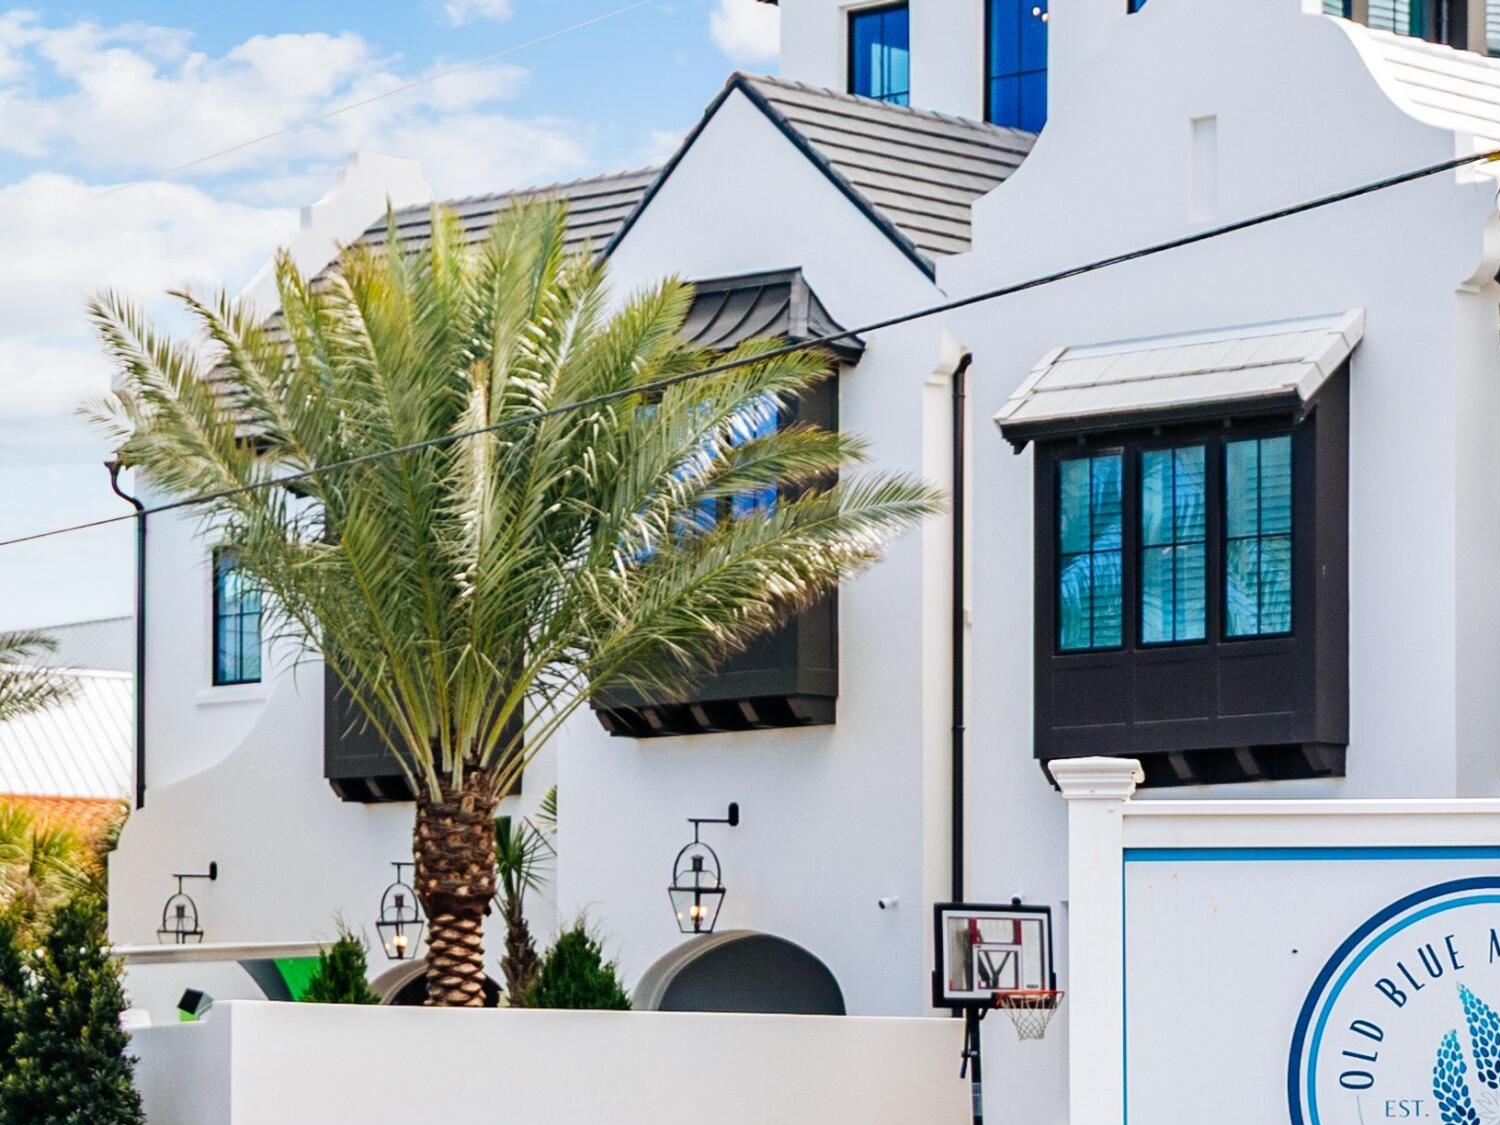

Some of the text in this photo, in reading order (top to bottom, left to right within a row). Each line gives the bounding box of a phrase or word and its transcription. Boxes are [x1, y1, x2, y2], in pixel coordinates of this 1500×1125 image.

[1338, 1018, 1385, 1090] OLD
[1374, 933, 1465, 1008] BLUE
[1385, 1099, 1429, 1119] EST.
